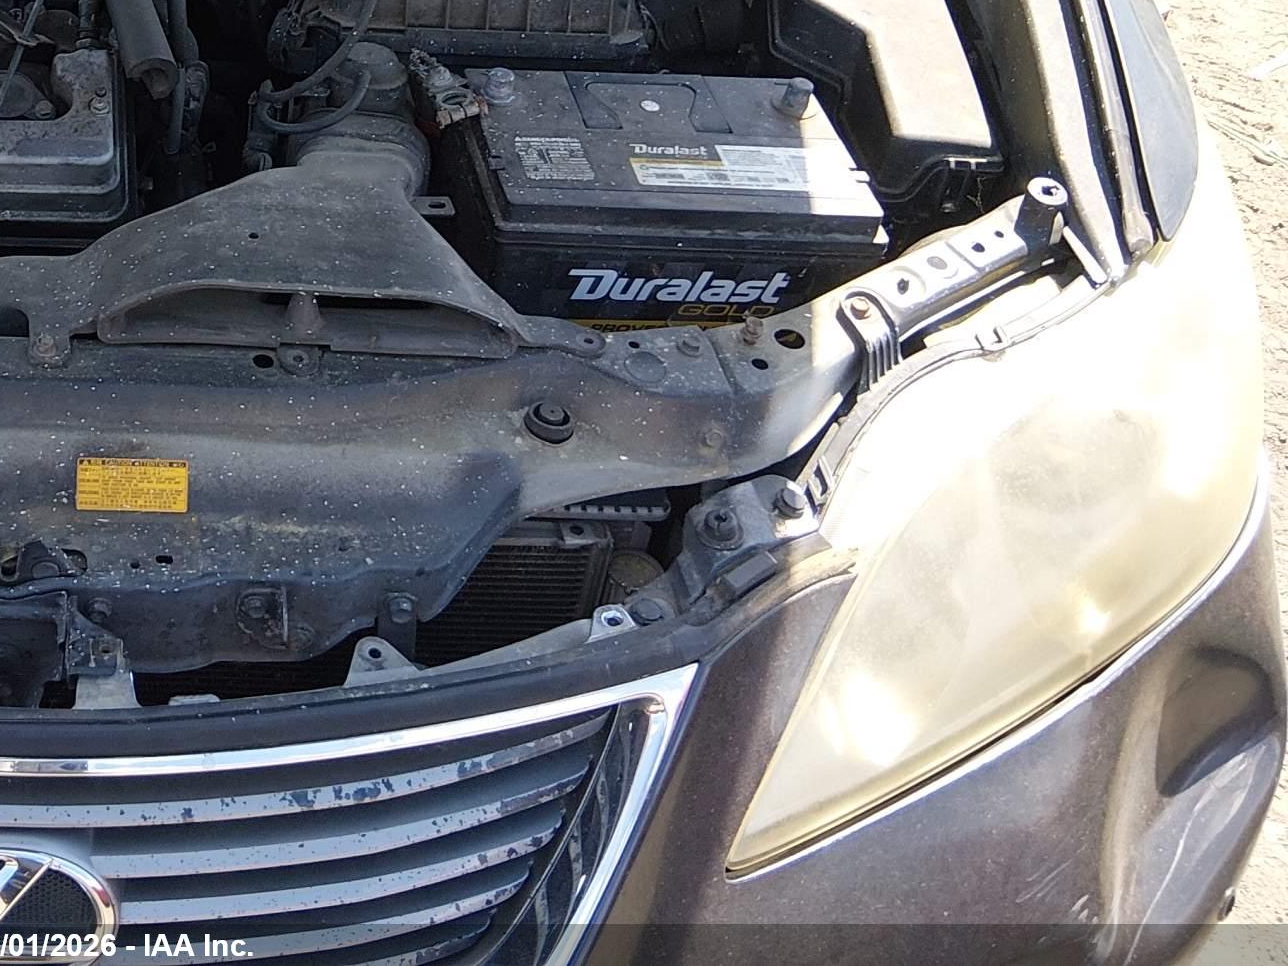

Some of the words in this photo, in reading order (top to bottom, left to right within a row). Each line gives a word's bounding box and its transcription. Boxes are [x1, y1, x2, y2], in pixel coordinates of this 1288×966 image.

[629, 143, 708, 156] Duralast
[568, 268, 791, 304] Duralast
[678, 303, 776, 318] GOLD
